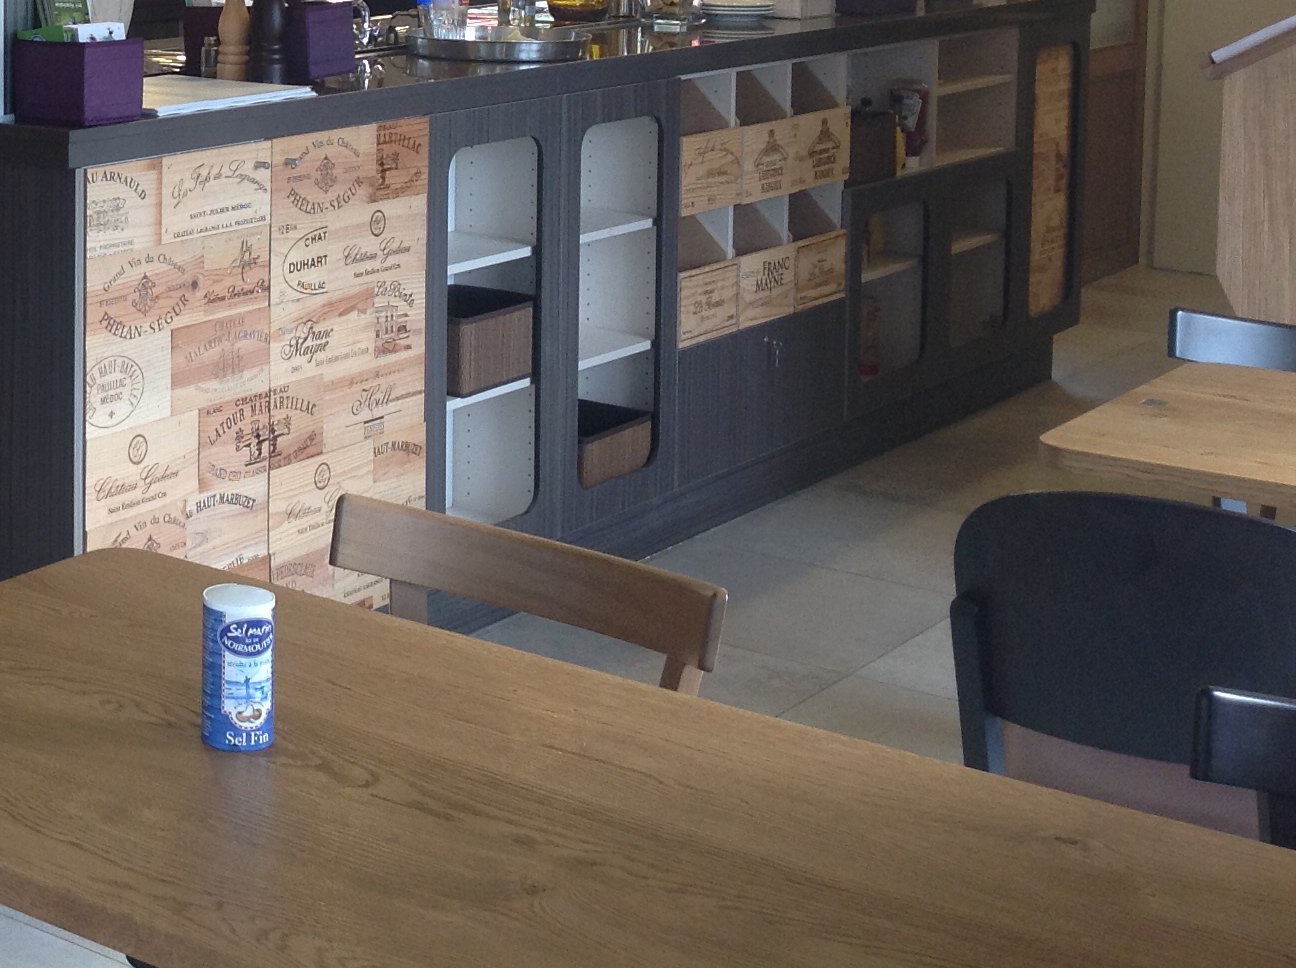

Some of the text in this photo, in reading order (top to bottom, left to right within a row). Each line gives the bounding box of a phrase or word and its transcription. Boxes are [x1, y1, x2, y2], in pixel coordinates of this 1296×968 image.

[101, 171, 147, 201] ARNAULD
[304, 231, 328, 248] CHAT
[103, 265, 126, 292] Grand
[128, 256, 142, 270] Vin
[144, 253, 154, 264] du
[288, 254, 328, 274] DUHART
[762, 256, 791, 276] FRANC
[754, 273, 784, 294] MAYNE
[281, 335, 329, 364] Mayne
[207, 408, 245, 446] LATOUR
[195, 492, 256, 514] HAUT-MARBUZET
[150, 515, 160, 525] du
[227, 623, 247, 637] Sel
[225, 730, 269, 746] Sel Fin
